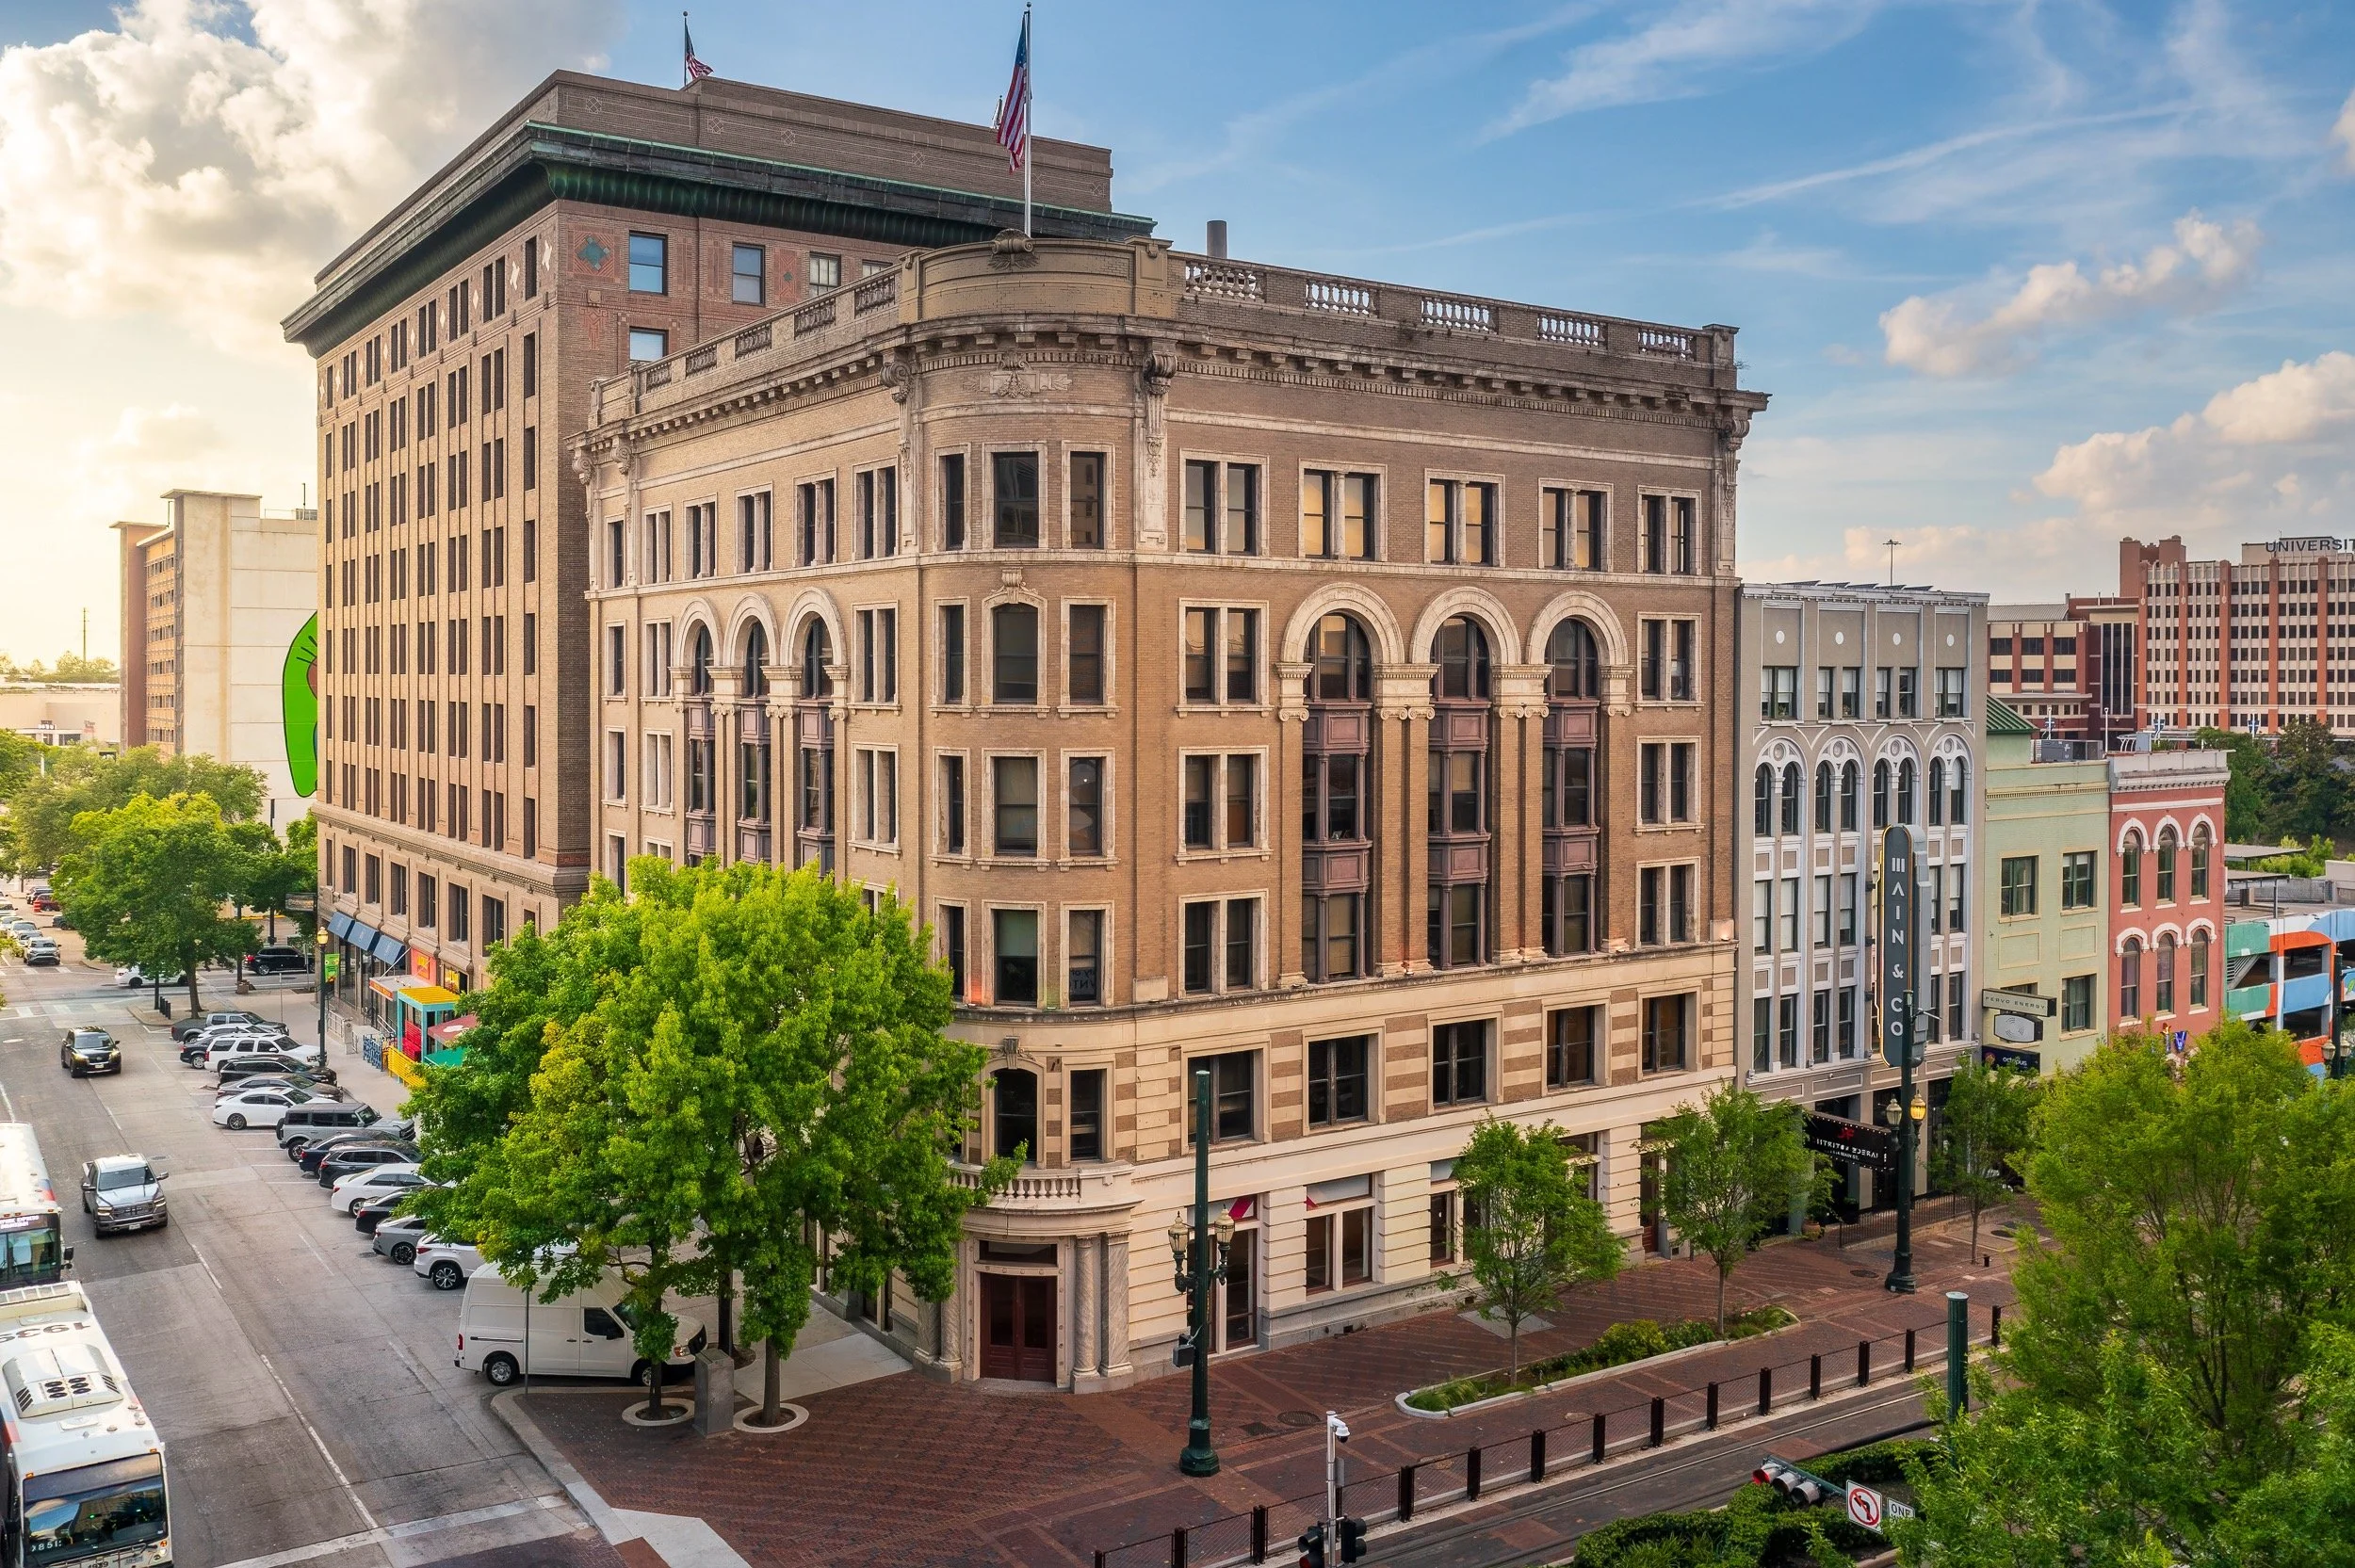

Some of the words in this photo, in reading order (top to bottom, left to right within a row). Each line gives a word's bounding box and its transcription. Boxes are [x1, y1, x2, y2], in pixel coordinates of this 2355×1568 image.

[1892, 857, 1906, 946] MAIN
[1892, 963, 1904, 979] &
[2014, 1001, 2045, 1010] ENERGY
